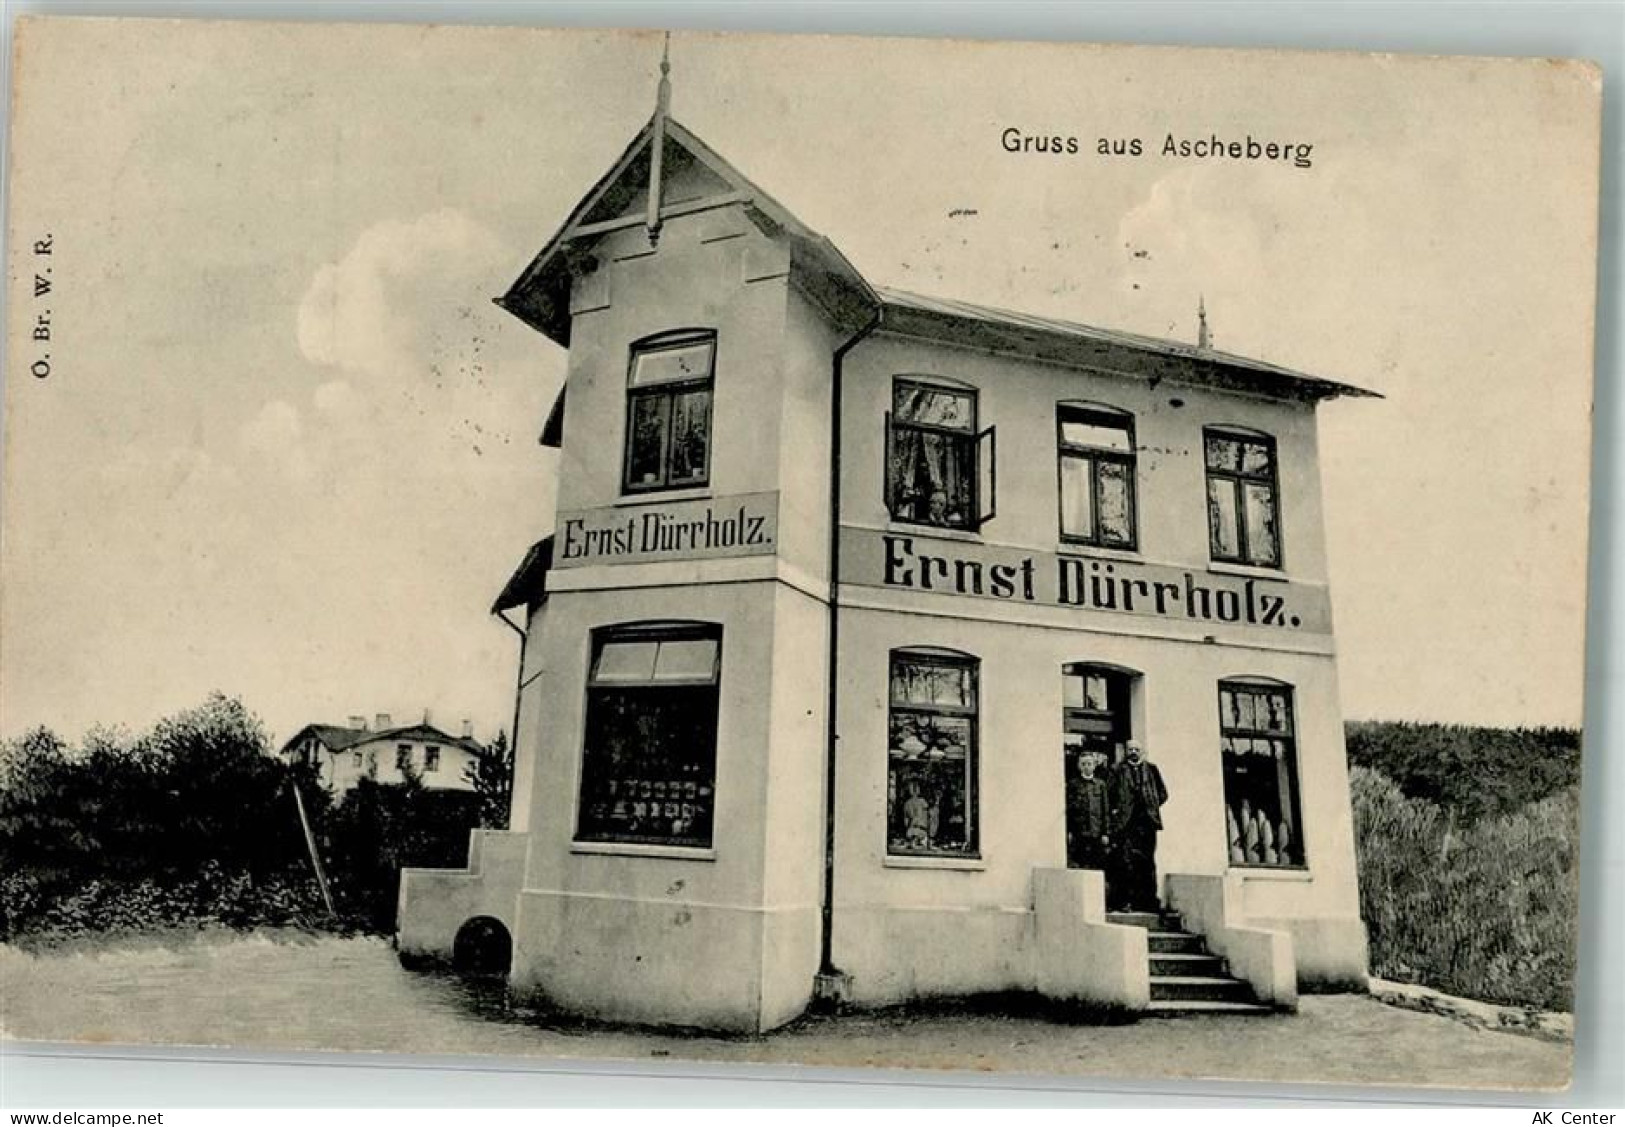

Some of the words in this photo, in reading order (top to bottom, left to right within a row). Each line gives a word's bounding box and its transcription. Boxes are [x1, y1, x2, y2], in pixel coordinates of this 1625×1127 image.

[561, 517, 636, 559] Ernst
[640, 505, 773, 553] Dürrholz.
[882, 534, 1035, 601] Ernst
[1056, 557, 1302, 629] Dürrholz.
